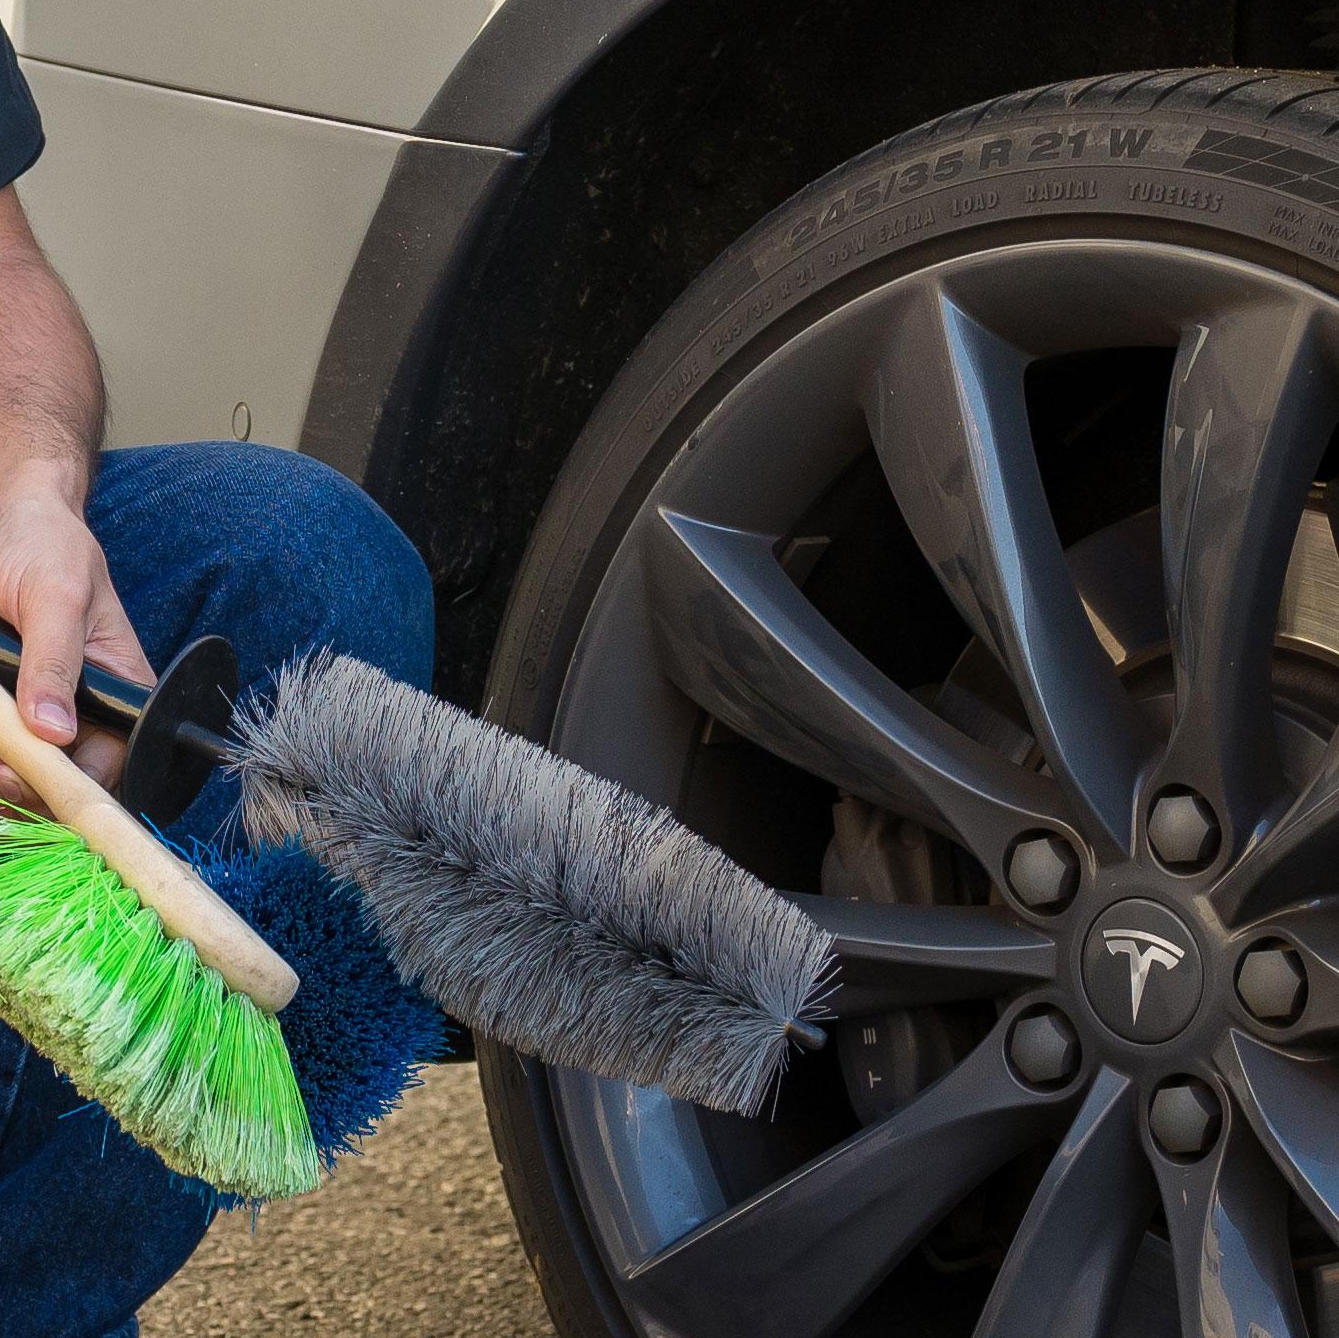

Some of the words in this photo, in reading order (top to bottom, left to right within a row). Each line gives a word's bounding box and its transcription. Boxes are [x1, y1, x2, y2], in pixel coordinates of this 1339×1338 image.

[778, 281, 793, 301] R
[795, 263, 817, 290] 21
[877, 205, 937, 245] EXTRA
[951, 190, 1001, 219] LOAD
[1024, 179, 1100, 204] RADIAL
[1128, 180, 1224, 213] TUBELESS
[784, 148, 965, 254] 245/35
[979, 138, 1014, 171] R
[1026, 128, 1091, 163] 21
[1109, 128, 1155, 159] W
